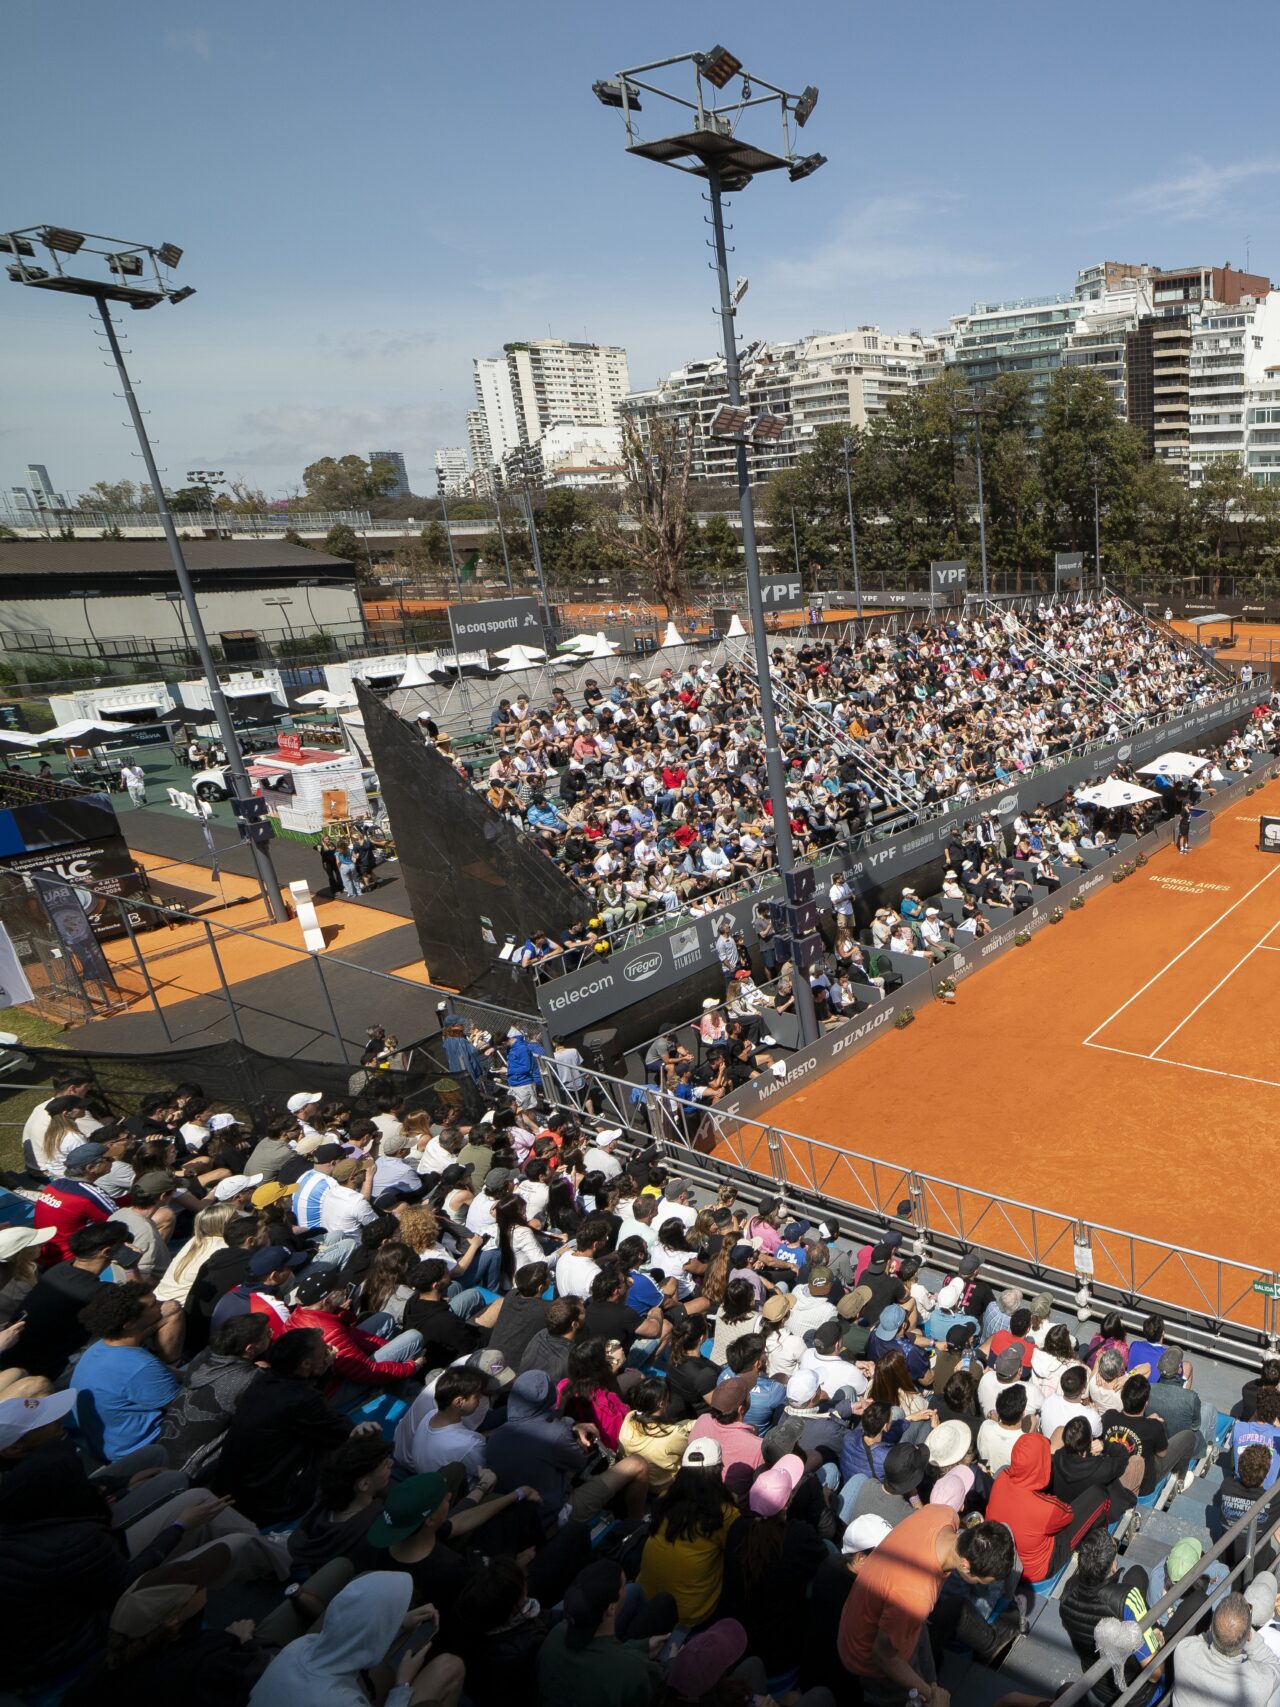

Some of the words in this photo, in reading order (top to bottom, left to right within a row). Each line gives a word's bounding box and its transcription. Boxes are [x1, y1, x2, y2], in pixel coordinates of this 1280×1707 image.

[937, 568, 966, 584] YPF
[761, 583, 801, 603] YPF
[456, 623, 467, 635] le
[466, 622, 488, 635] coq
[487, 617, 519, 632] sportif
[1184, 719, 1196, 729] YPF
[15, 859, 55, 871] importante
[72, 848, 105, 859] Patagonia
[868, 846, 897, 867] YPF
[93, 882, 120, 893] Octubre
[1149, 874, 1194, 887] BUENOS
[1199, 881, 1231, 892] AIRES
[1161, 883, 1205, 894] CIUDAD
[981, 927, 1017, 957] smartwater
[548, 975, 615, 1012] telecom
[831, 1006, 895, 1056] DUNLOP
[758, 1057, 818, 1101] MANIFESTO
[1254, 1283, 1274, 1293] SALIDA
[1231, 1496, 1251, 1506] WORLD
